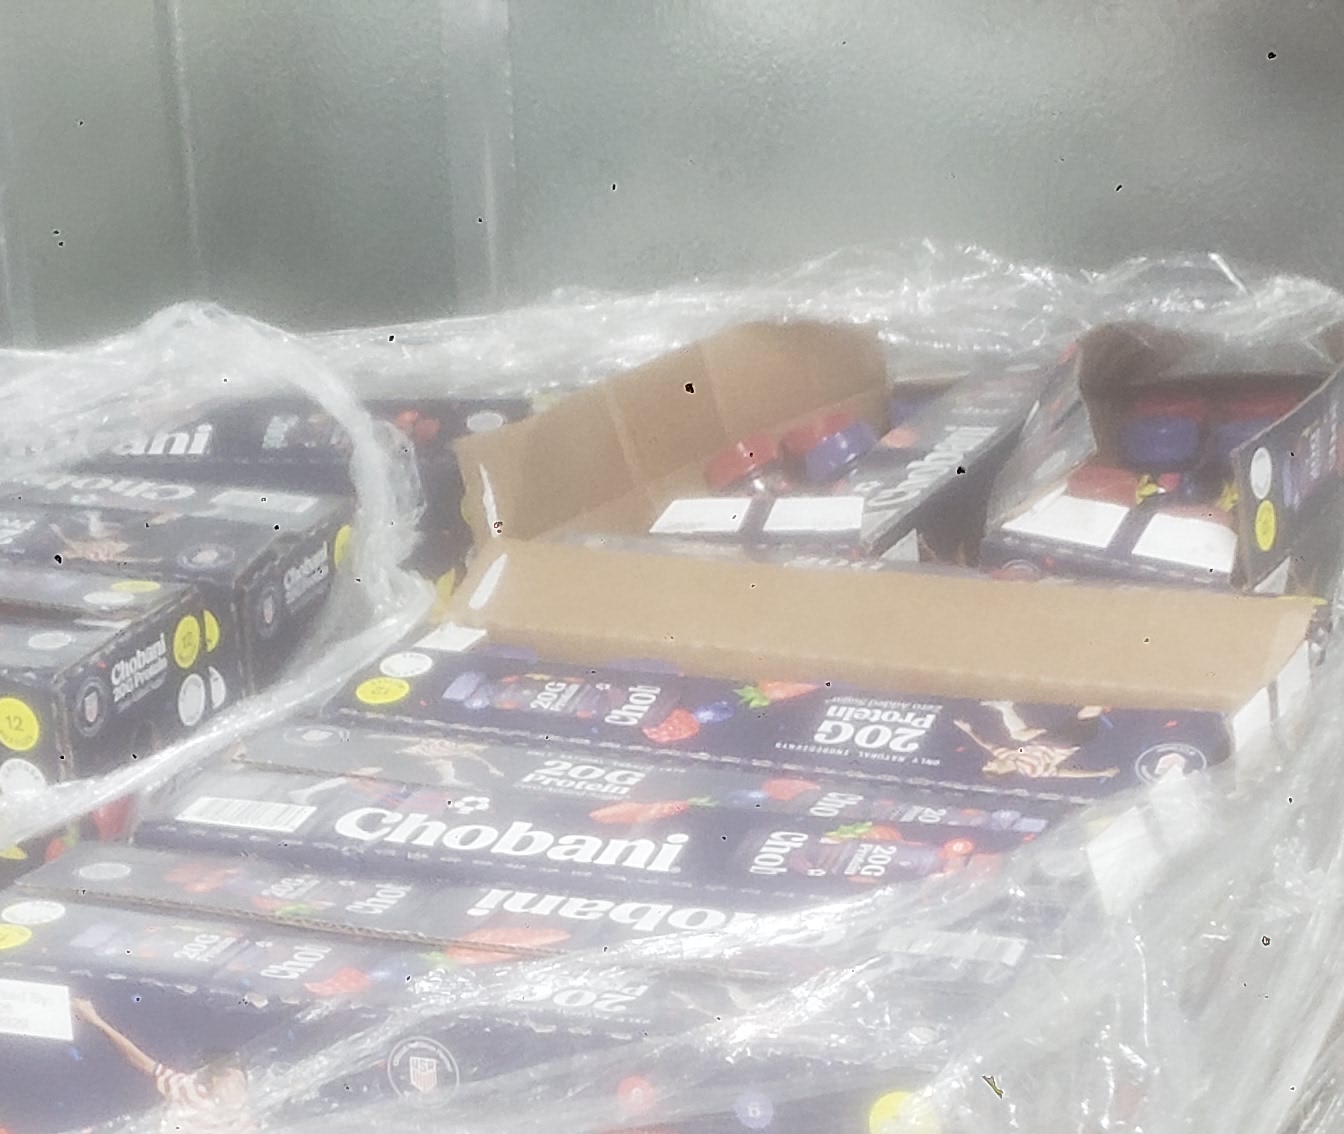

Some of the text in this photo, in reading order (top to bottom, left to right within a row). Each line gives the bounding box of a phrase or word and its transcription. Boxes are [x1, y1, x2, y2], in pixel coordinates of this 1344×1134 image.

[111, 631, 167, 686] Chobani
[530, 681, 567, 711] 20G
[825, 704, 937, 729] Protein
[813, 719, 926, 753] 20G
[521, 772, 633, 796] Protein
[535, 759, 648, 788] 20G
[335, 805, 691, 874] Chobani
[859, 843, 898, 878] 20G
